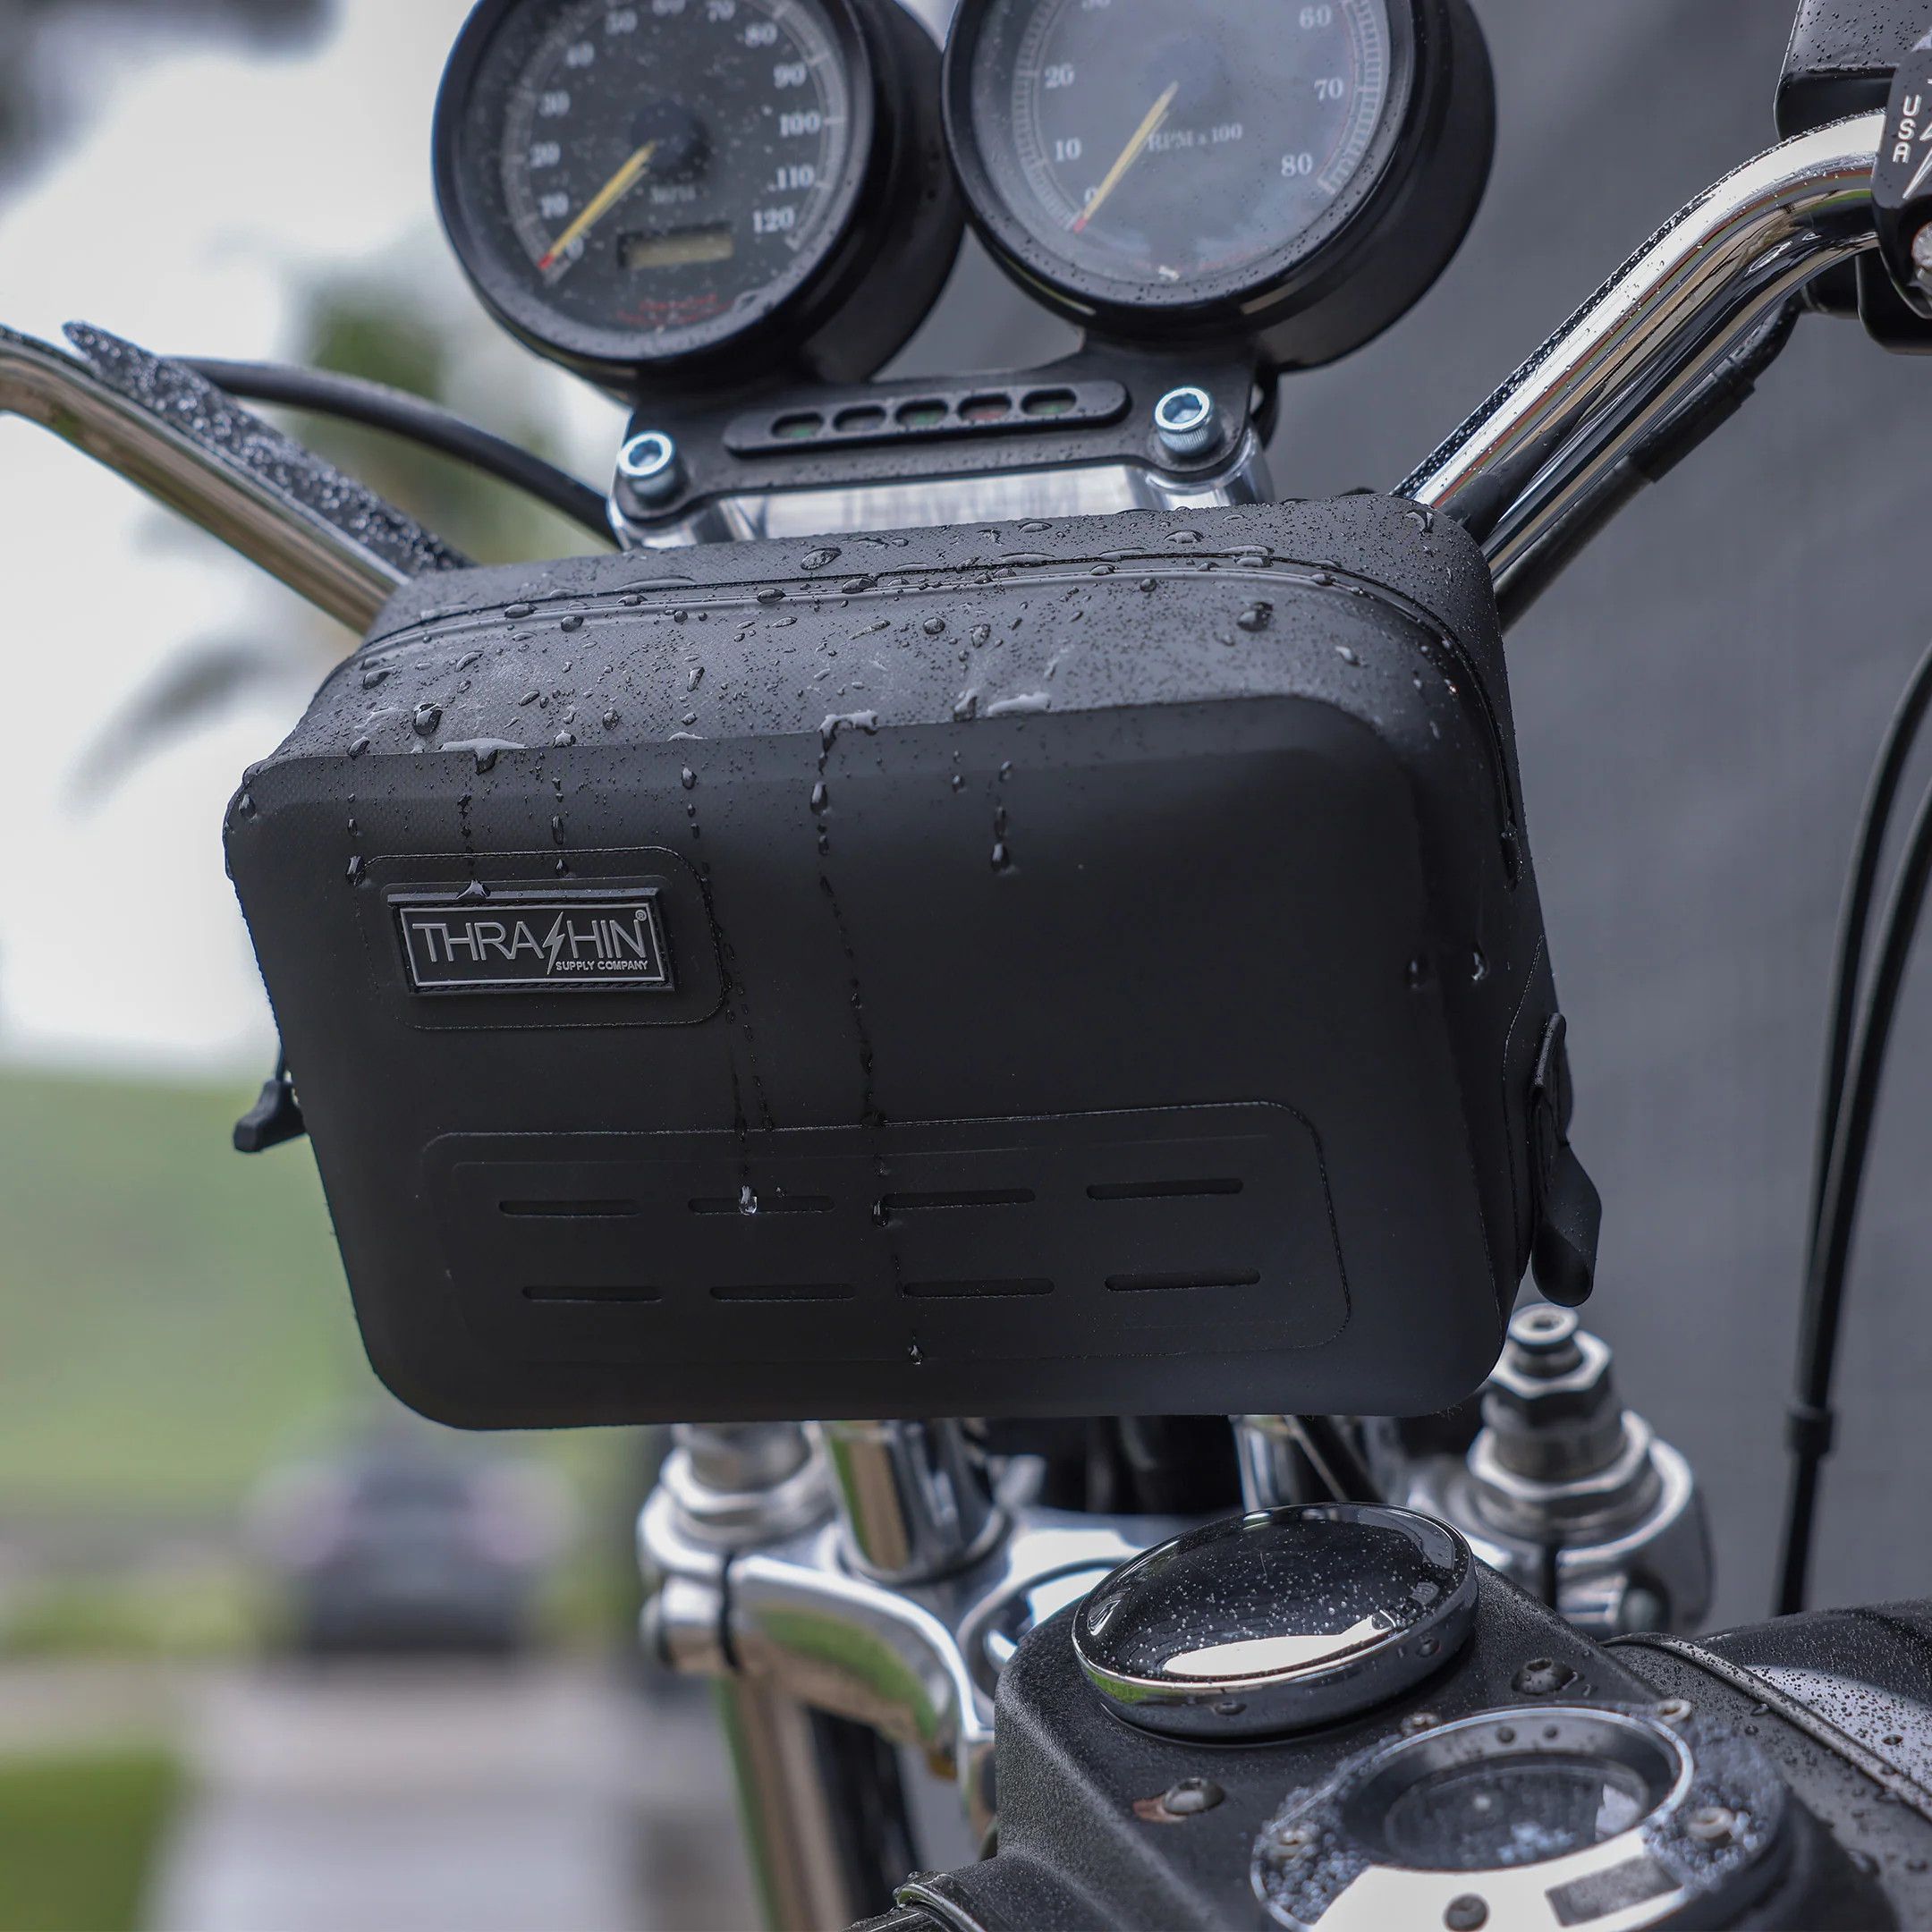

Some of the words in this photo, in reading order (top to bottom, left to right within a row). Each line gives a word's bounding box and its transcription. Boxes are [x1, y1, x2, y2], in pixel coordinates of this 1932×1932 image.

[1299, 4, 1331, 29] 60
[744, 21, 778, 48] 80
[773, 62, 807, 89] 90
[1044, 64, 1074, 89] 20
[1314, 77, 1343, 101] 70
[779, 109, 821, 138] 100
[1892, 94, 1922, 164] USA
[1055, 137, 1081, 162] 10
[1148, 130, 1194, 151] RPM
[1211, 123, 1243, 144] 100
[1281, 152, 1313, 177] 80
[776, 165, 815, 191] 110
[540, 191, 569, 219] 10
[753, 207, 795, 234] 120
[566, 235, 584, 260] 0
[555, 961, 595, 971] SUPPLY
[597, 960, 648, 970] COMPANY
